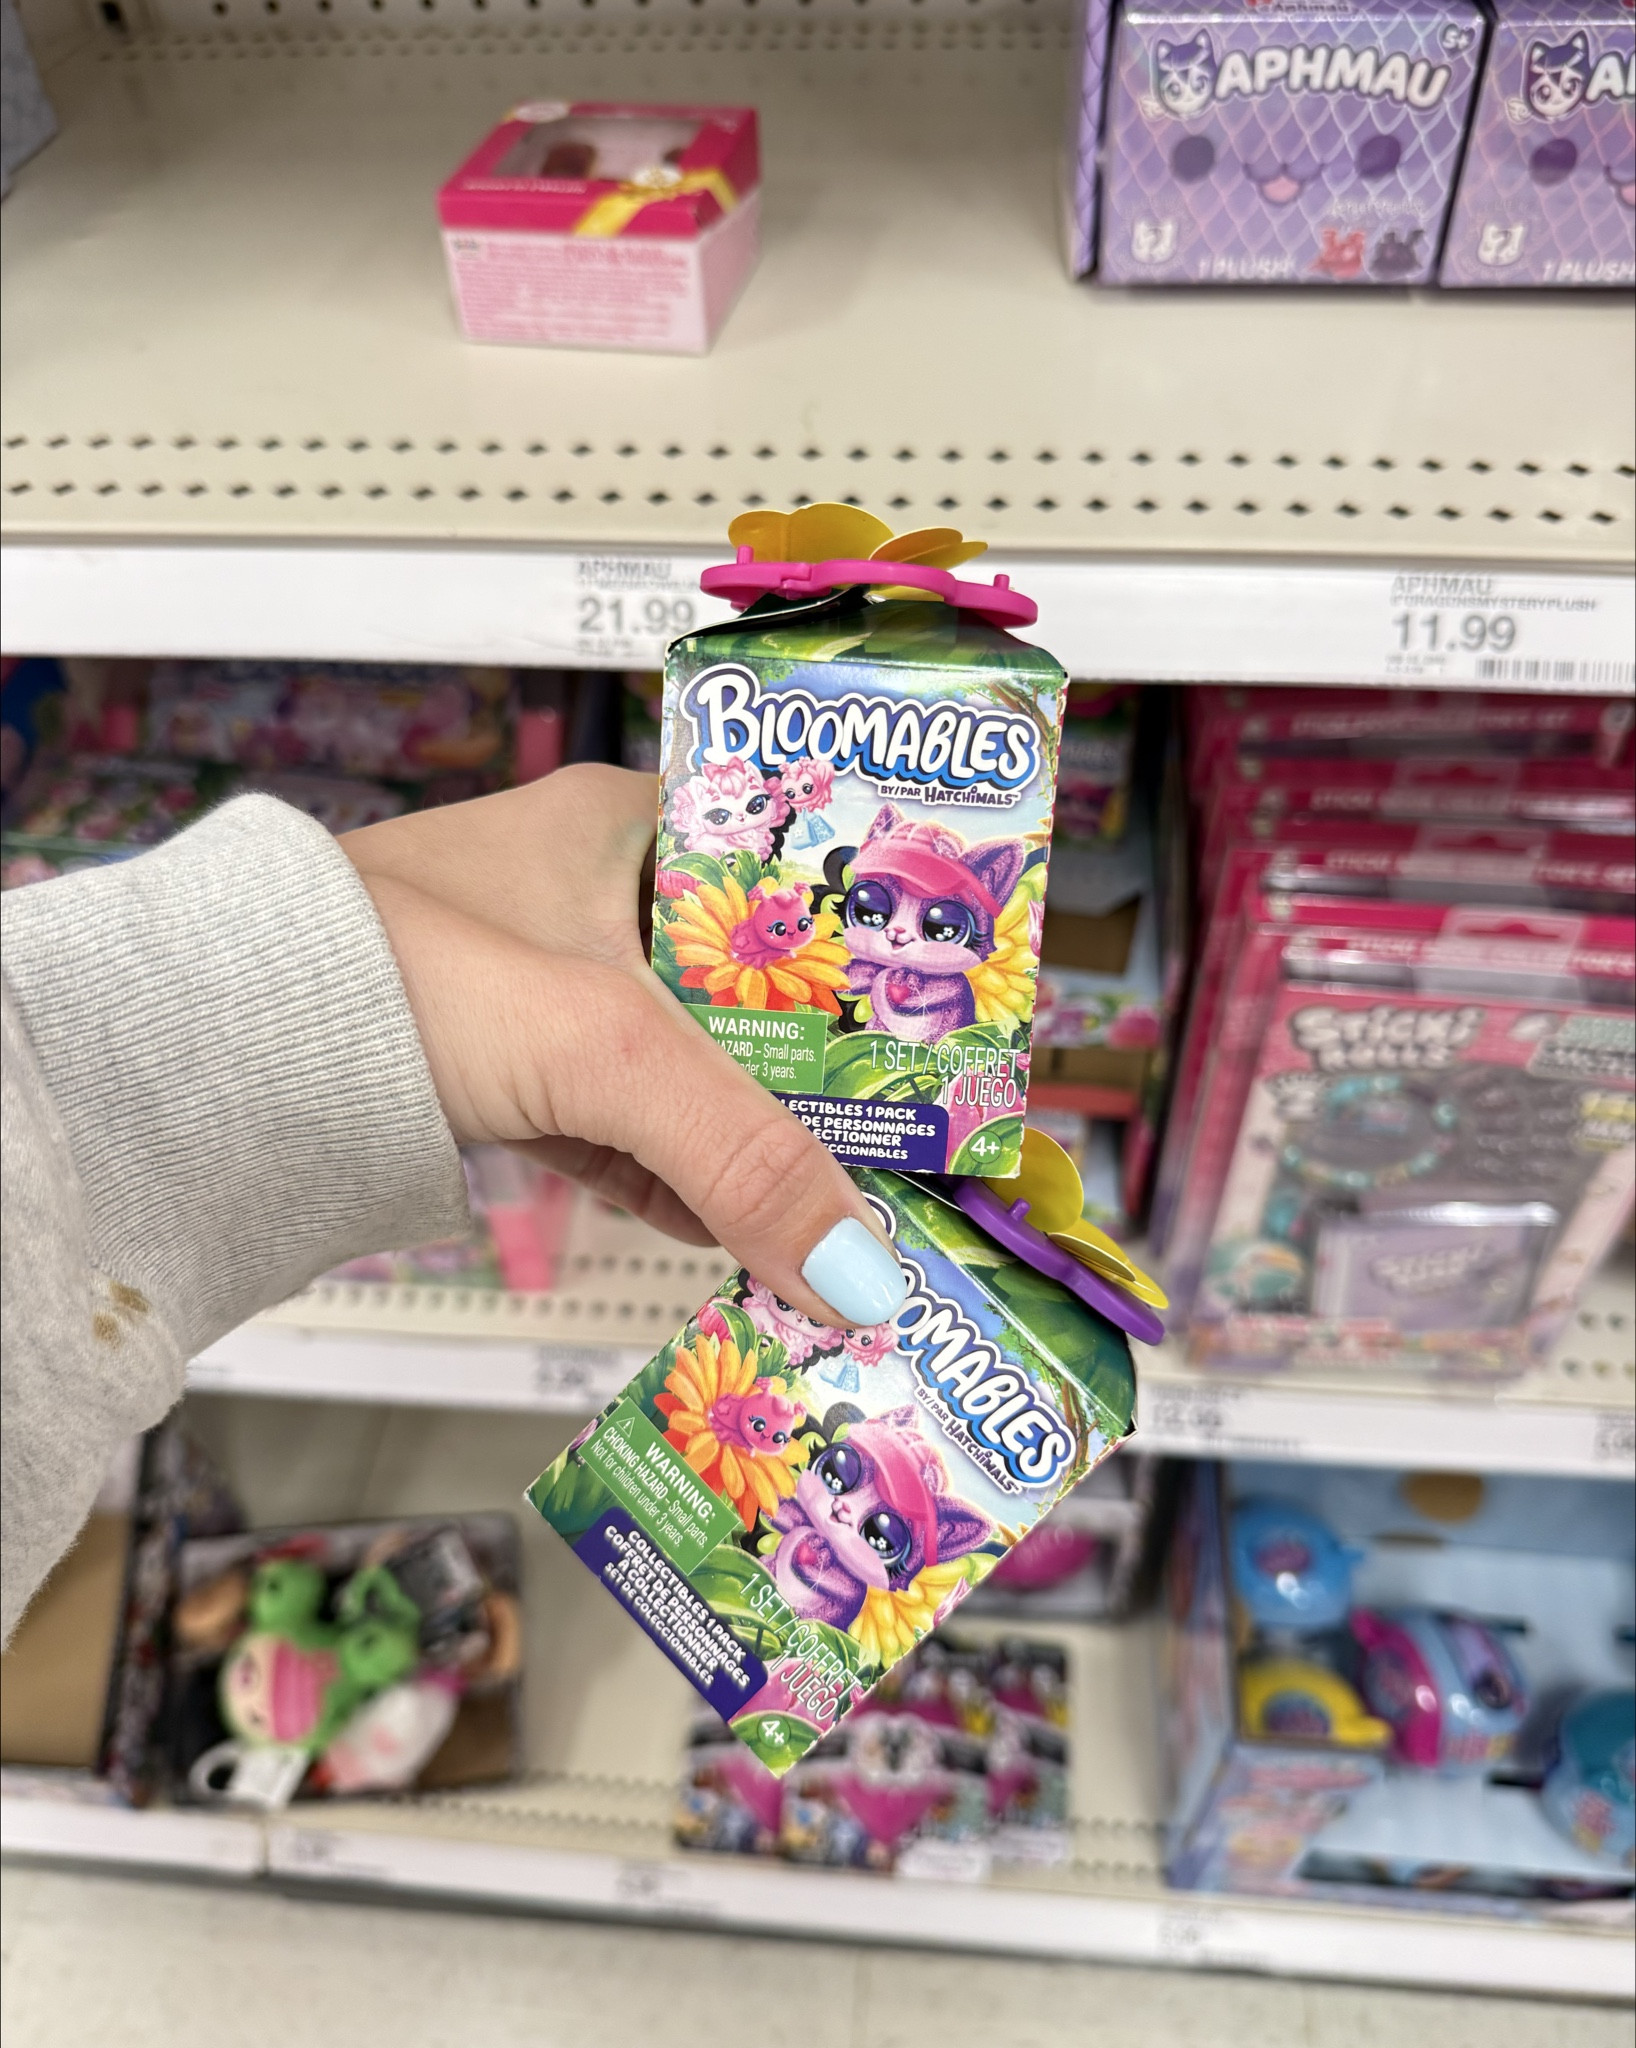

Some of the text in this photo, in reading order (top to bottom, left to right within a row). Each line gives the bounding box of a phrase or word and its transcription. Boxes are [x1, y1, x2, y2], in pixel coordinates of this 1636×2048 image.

[1214, 44, 1450, 108] APHMAU
[578, 597, 696, 635] 21.99
[1391, 611, 1516, 653] 11.99
[692, 669, 1035, 783] BLOOMABLES
[708, 1015, 805, 1041] WARNING:
[717, 1039, 754, 1057] AZARD
[763, 1042, 790, 1060] Small
[790, 1046, 816, 1064] parts.
[762, 1061, 769, 1077] 3
[769, 1065, 797, 1081] years.
[870, 1039, 878, 1070] 1
[884, 1040, 921, 1072] SET
[936, 1044, 1021, 1078] COFFRET
[781, 1098, 863, 1117] ECTIBLES
[941, 1075, 1018, 1109] 1 JUEGO
[800, 1114, 936, 1137] DE PERSONNAGES
[812, 1128, 902, 1147] ECTIONNER
[970, 1135, 1000, 1157] 4+
[823, 1142, 909, 1160] CCIONABLES
[887, 1262, 1070, 1480] OMABLES
[590, 1438, 684, 1548] Not for children under 3 years.
[602, 1426, 641, 1468] CHOKING
[633, 1460, 669, 1501] HAZARD
[668, 1499, 694, 1529] Small
[685, 1520, 708, 1548] parts.
[645, 1441, 716, 1524] WARNING:
[628, 1530, 710, 1621] COLLECTIBLES
[604, 1525, 751, 1688] COFFRET DE PERSONNAGES
[604, 1561, 715, 1687] SET DE COLECCIONABLES
[627, 1567, 719, 1672] COLLECTIONNER
[740, 1572, 760, 1595] 1
[750, 1583, 791, 1625] SET
[786, 1623, 863, 1701] COFFRET
[771, 1649, 839, 1721] 1 JUEGO
[761, 1720, 785, 1745] 4+
